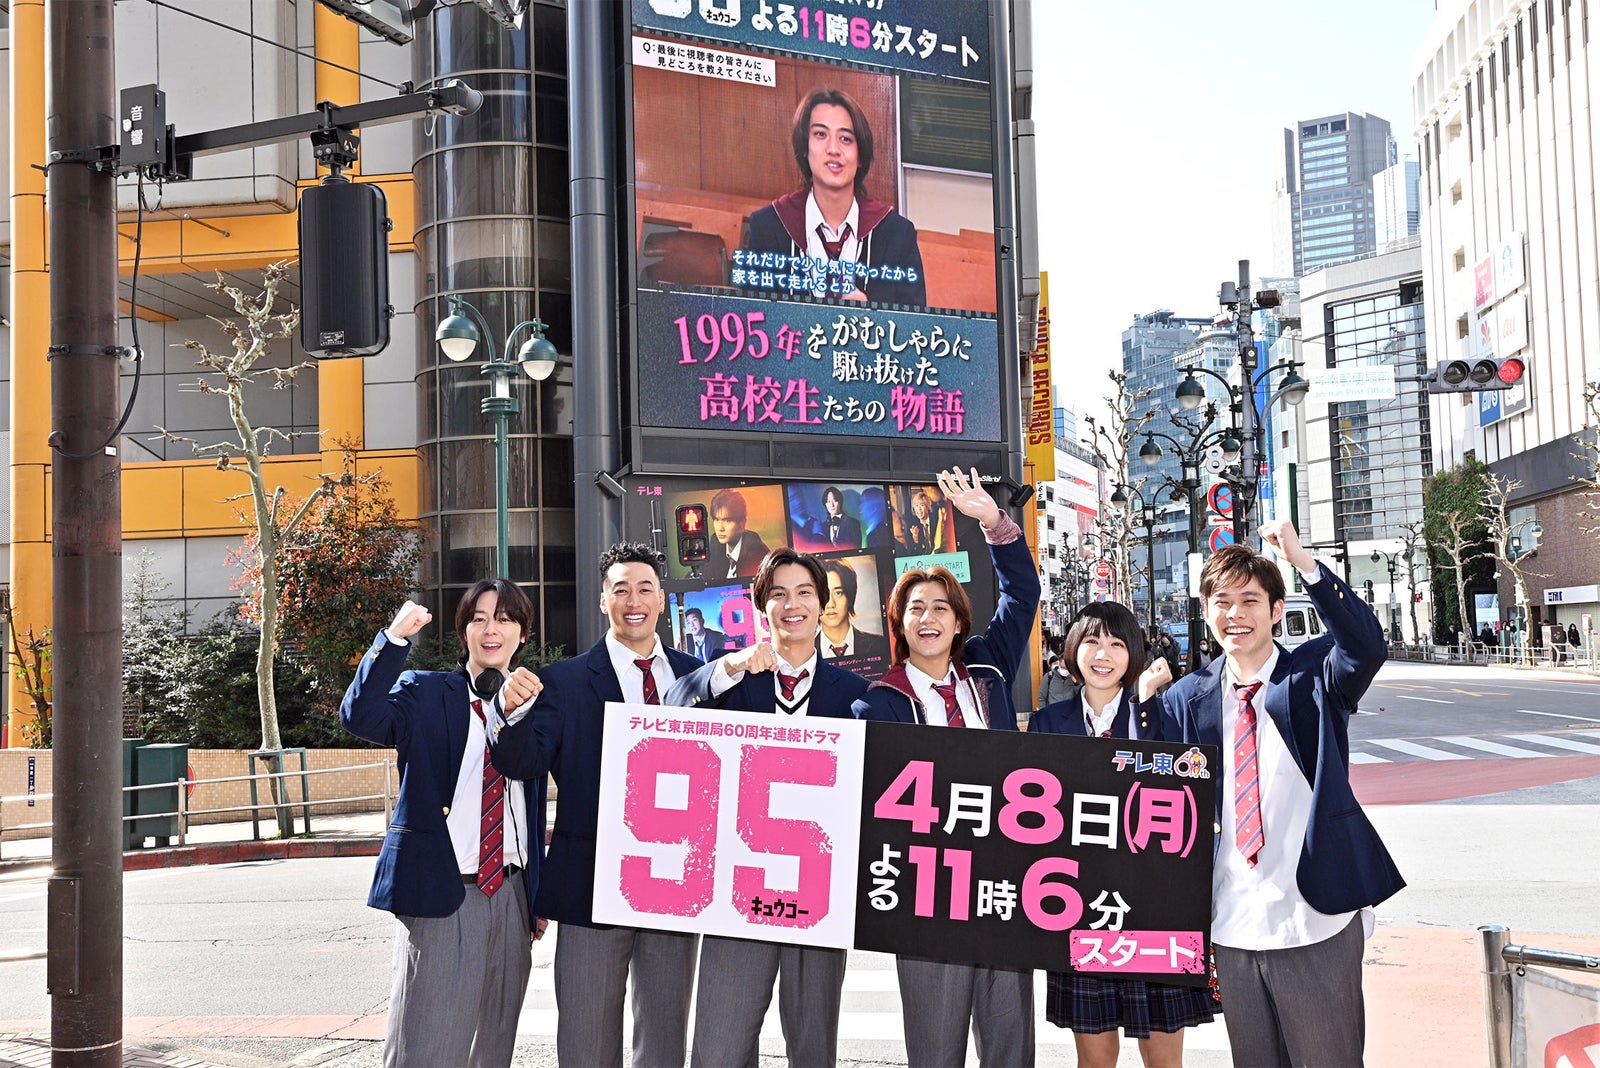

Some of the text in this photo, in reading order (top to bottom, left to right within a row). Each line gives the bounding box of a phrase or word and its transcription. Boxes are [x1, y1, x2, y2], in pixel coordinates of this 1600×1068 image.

[751, 5, 980, 67] よる11時6分スタート
[658, 56, 772, 83] 見どころを教えてください
[732, 250, 918, 282] それだけで少し気になったから
[732, 269, 855, 293] 家を出て走れるとか
[832, 351, 940, 387] 駆け抜けた
[1029, 368, 1051, 446] RECORDS
[637, 486, 663, 496] テレ東
[629, 716, 841, 744] テレビ東京開局60周年連続ドラマ
[1112, 750, 1173, 775] テレ東
[873, 759, 1199, 859] 4月8日(月)
[620, 736, 838, 930] 95
[751, 896, 809, 919] キュウゴー
[1077, 935, 1196, 969] スタート
